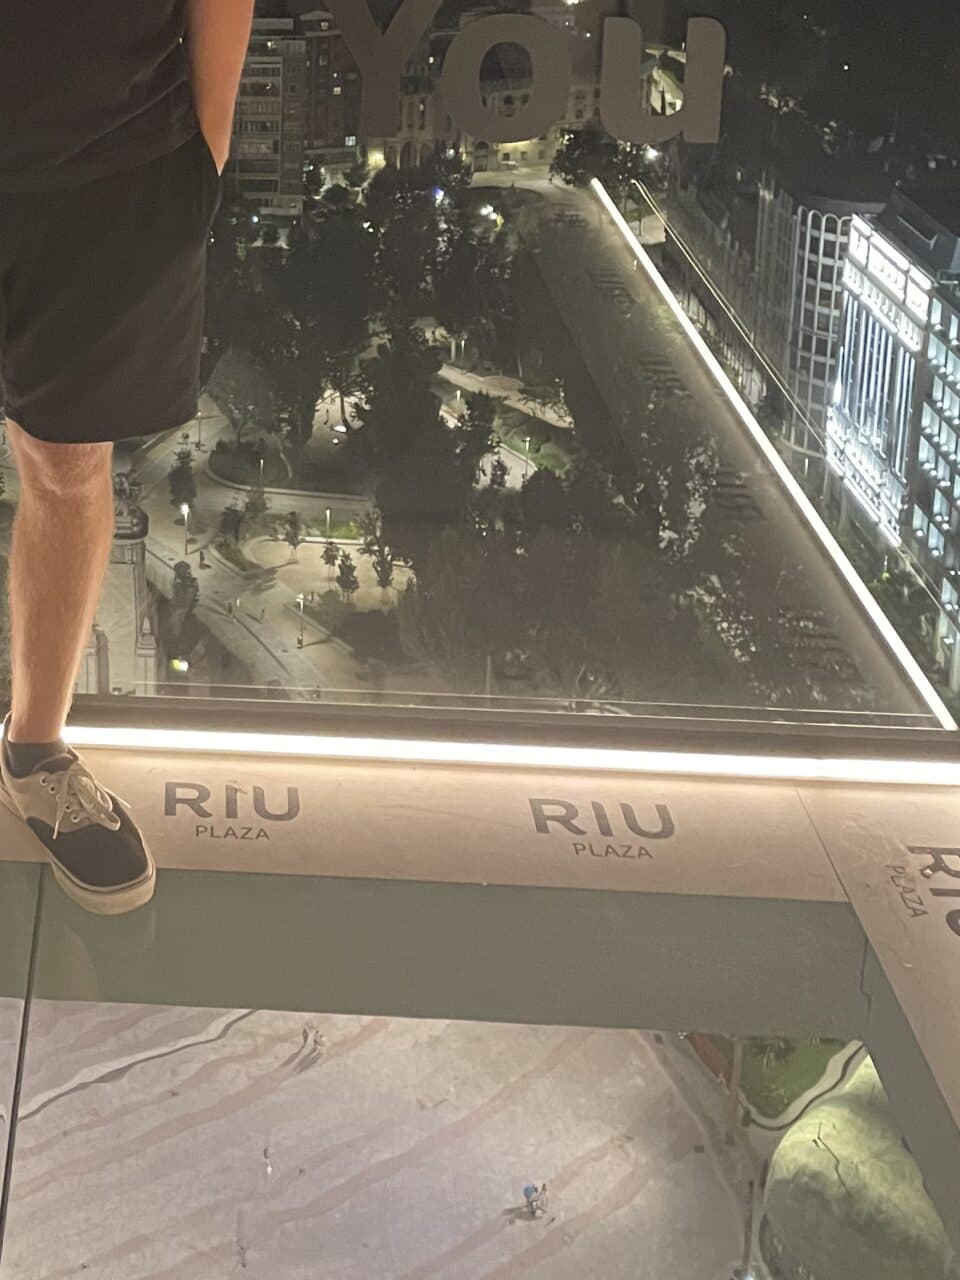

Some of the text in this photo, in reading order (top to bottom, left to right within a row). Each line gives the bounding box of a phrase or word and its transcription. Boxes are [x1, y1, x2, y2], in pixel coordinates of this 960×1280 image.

[164, 781, 301, 822] RIU
[195, 825, 271, 841] PLAZA
[528, 797, 676, 840] RIU
[572, 842, 655, 860] PLAZA
